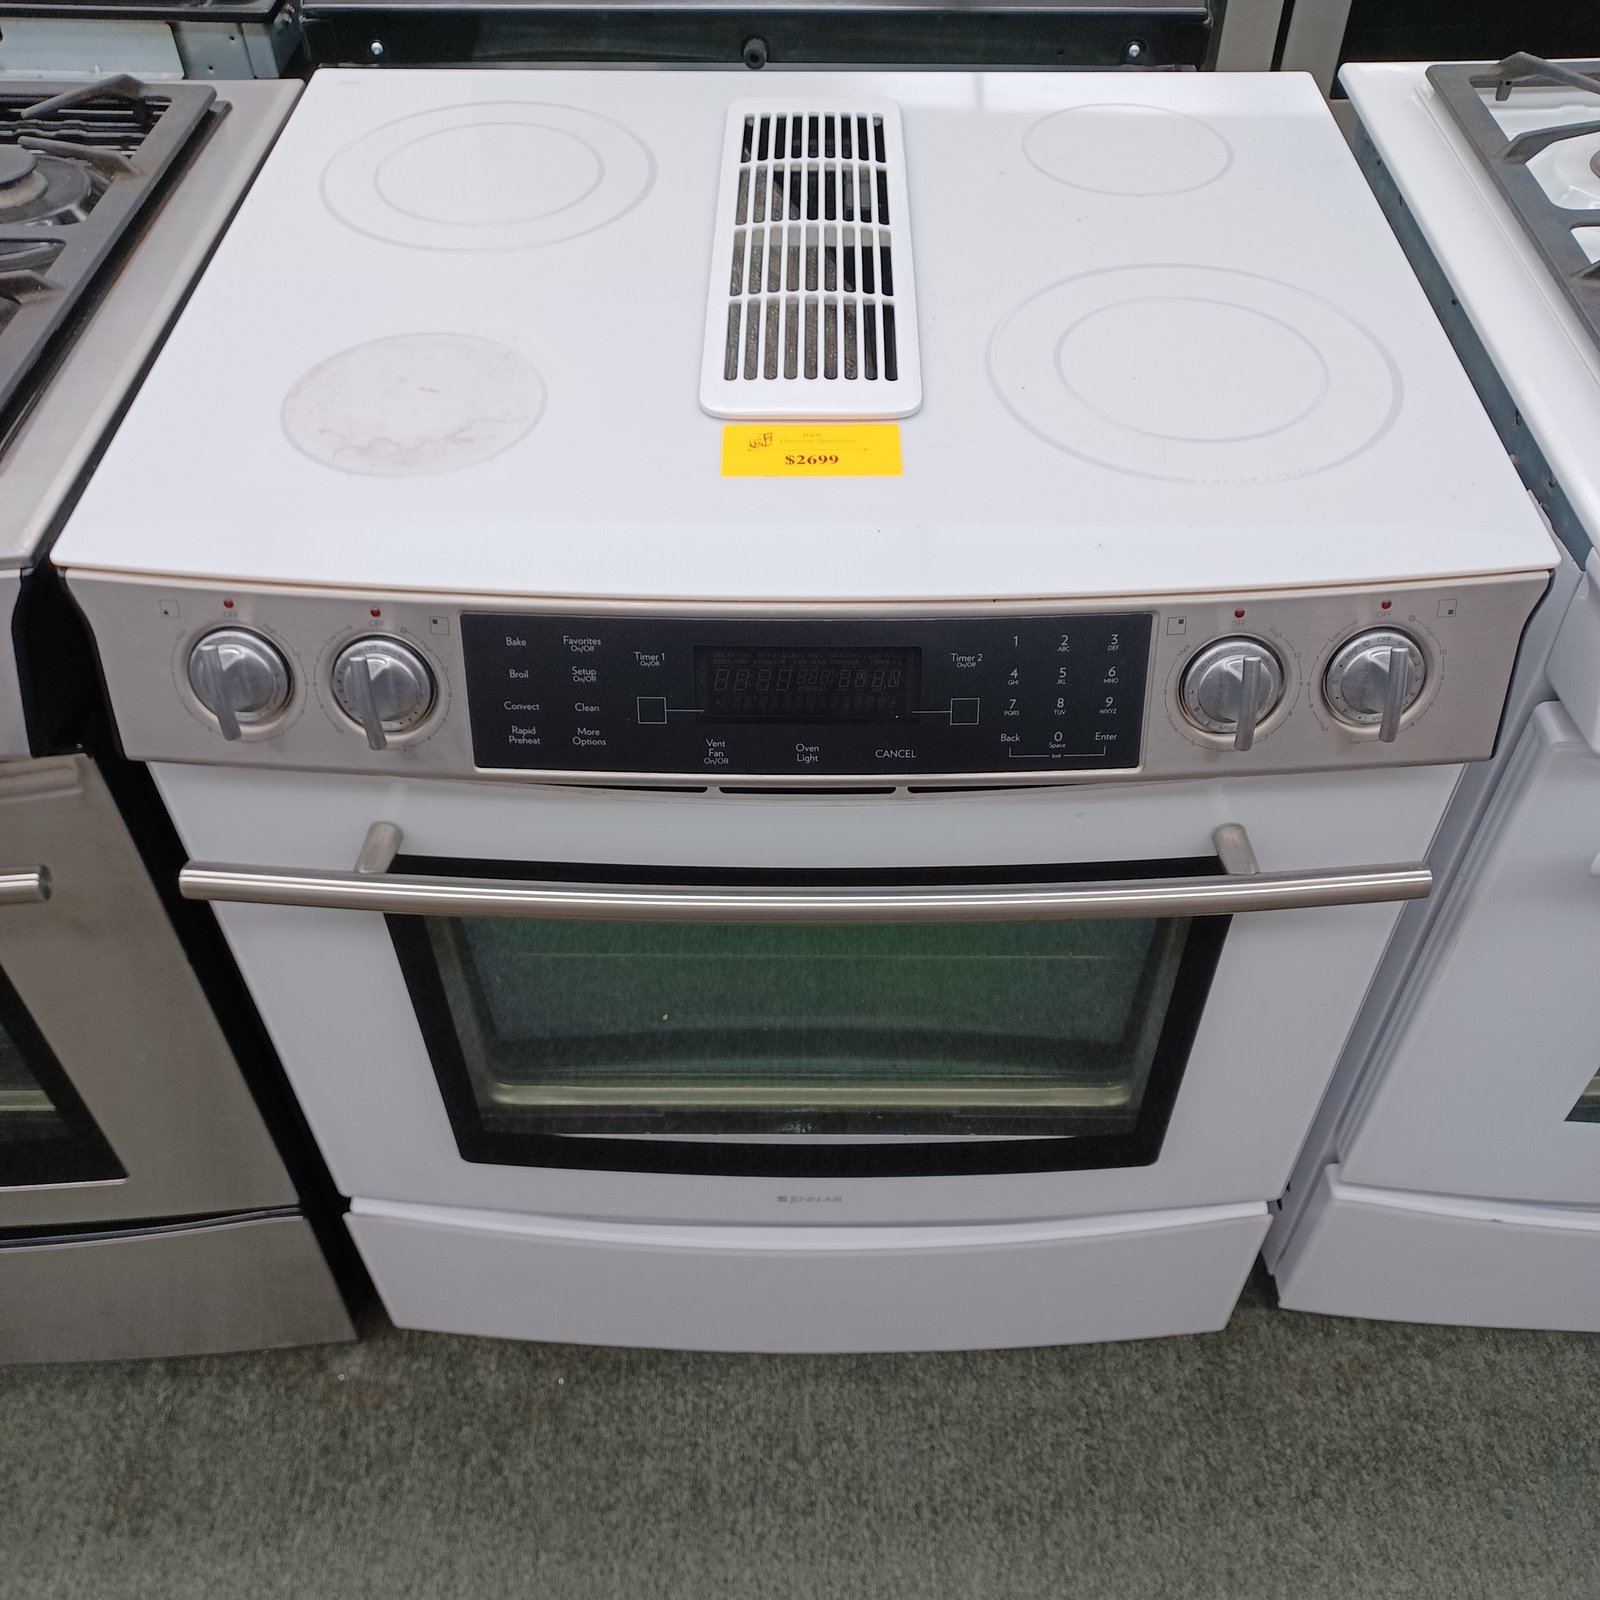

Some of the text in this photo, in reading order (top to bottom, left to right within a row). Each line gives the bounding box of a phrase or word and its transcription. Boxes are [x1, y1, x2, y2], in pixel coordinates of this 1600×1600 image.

[785, 454, 839, 465] $2699
[505, 637, 527, 646] Bake
[563, 635, 601, 646] Favorites
[1013, 636, 1018, 646] 1
[1061, 635, 1068, 645] 2
[1112, 634, 1119, 644] 3
[634, 652, 659, 661] Timer
[951, 653, 975, 662] Timer
[509, 669, 529, 678] Broil
[572, 666, 596, 676] Setup
[1011, 668, 1018, 678] 4
[1060, 667, 1066, 678] 5
[1108, 666, 1116, 677] 6
[504, 701, 540, 711] Convect
[1010, 699, 1016, 709] 7
[1057, 698, 1064, 708] 8
[1106, 696, 1113, 707] 9
[575, 702, 599, 712] Clean
[512, 726, 536, 736] Rapid
[578, 728, 600, 736] More
[508, 736, 540, 745] Preheat
[1001, 733, 1020, 742] Back
[1054, 732, 1062, 742] 0
[1095, 732, 1118, 741] Enter
[572, 737, 606, 747] Options
[706, 739, 725, 748] Vent
[796, 743, 820, 752] Oven
[708, 749, 724, 758] Fan
[875, 750, 916, 758] CANCEL
[797, 754, 818, 764] Light
